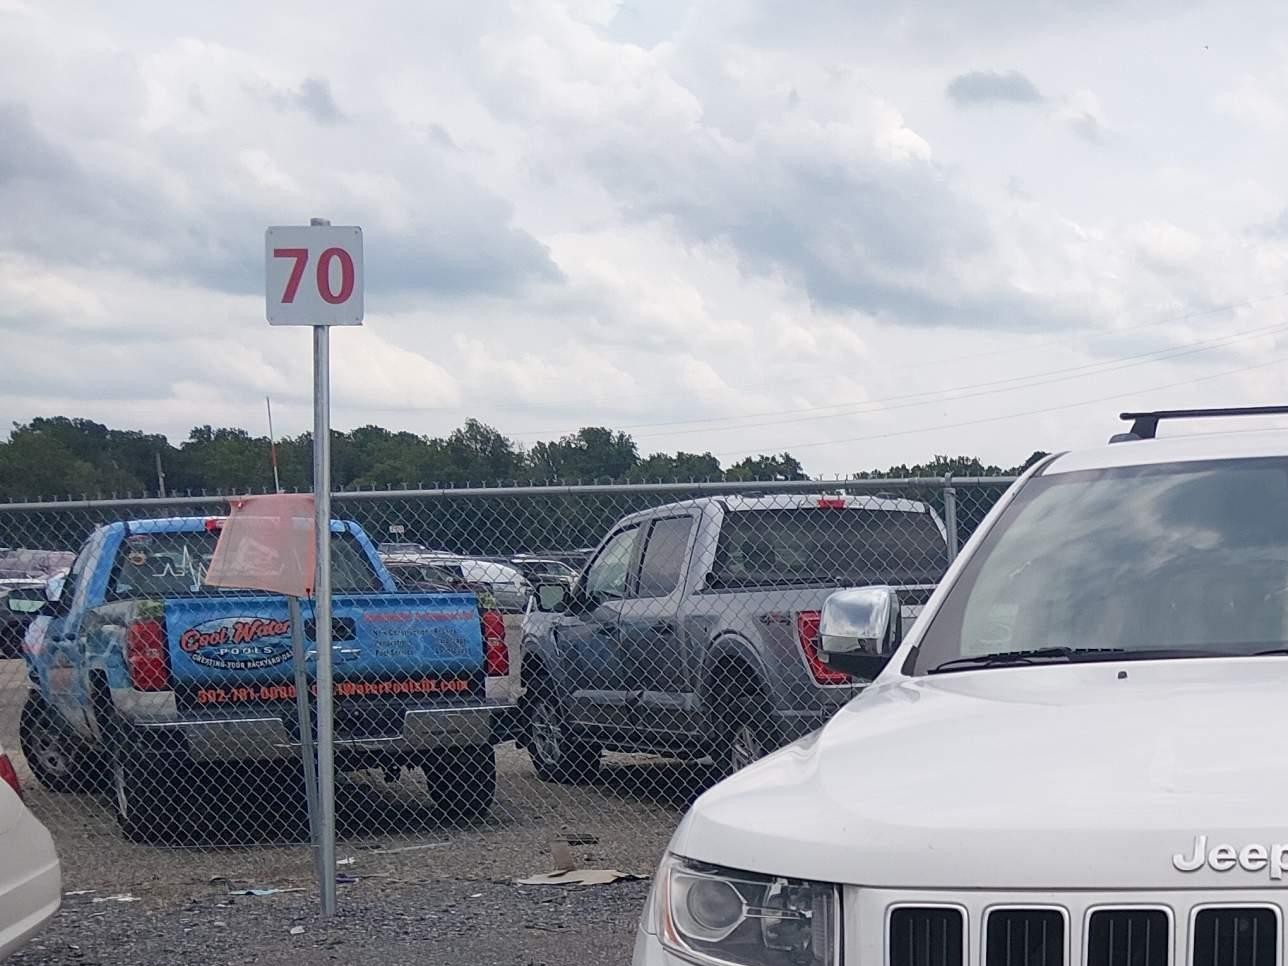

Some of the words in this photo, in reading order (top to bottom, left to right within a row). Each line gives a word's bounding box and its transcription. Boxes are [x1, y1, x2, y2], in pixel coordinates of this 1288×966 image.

[273, 247, 355, 305] 70
[180, 627, 228, 653] Cool
[232, 619, 291, 644] Water
[219, 646, 273, 656] POOLS
